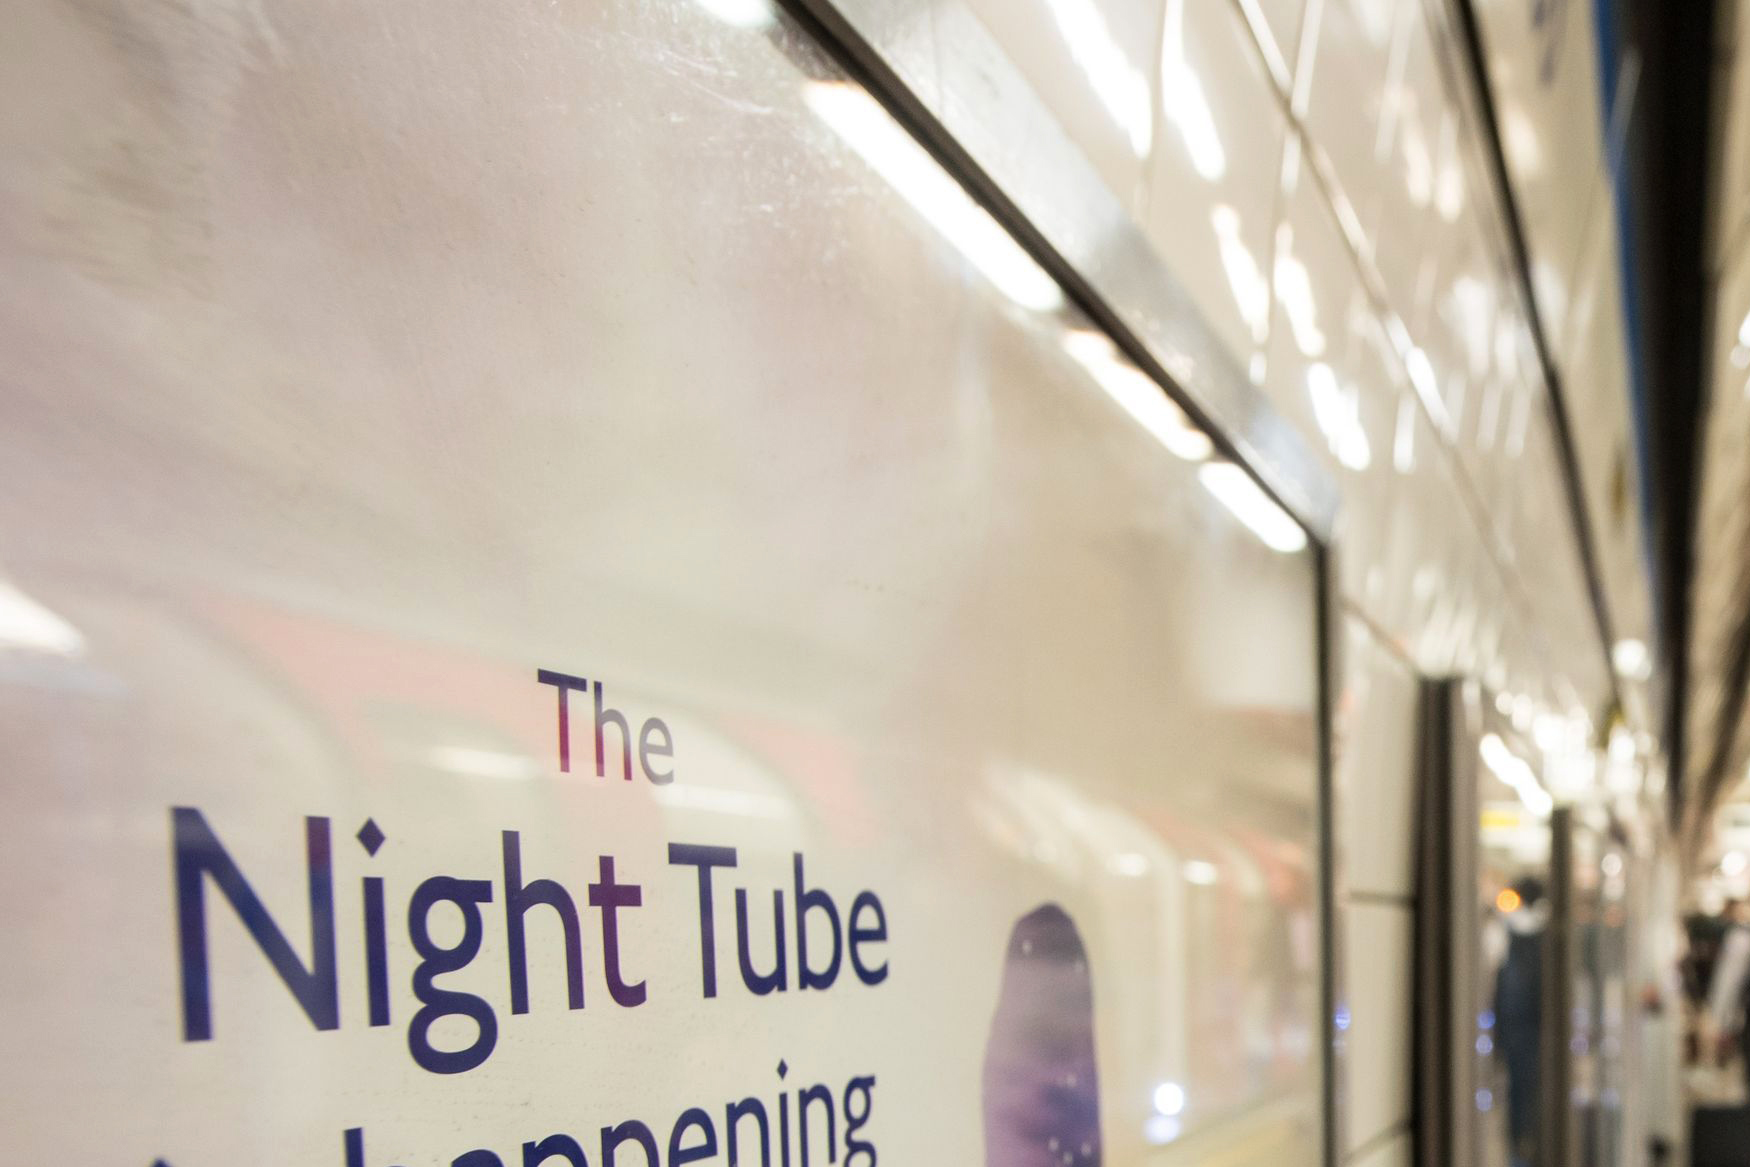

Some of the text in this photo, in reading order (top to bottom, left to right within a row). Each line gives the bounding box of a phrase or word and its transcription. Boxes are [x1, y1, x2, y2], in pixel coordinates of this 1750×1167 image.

[537, 668, 676, 787] The
[169, 805, 891, 1076] Night Tube
